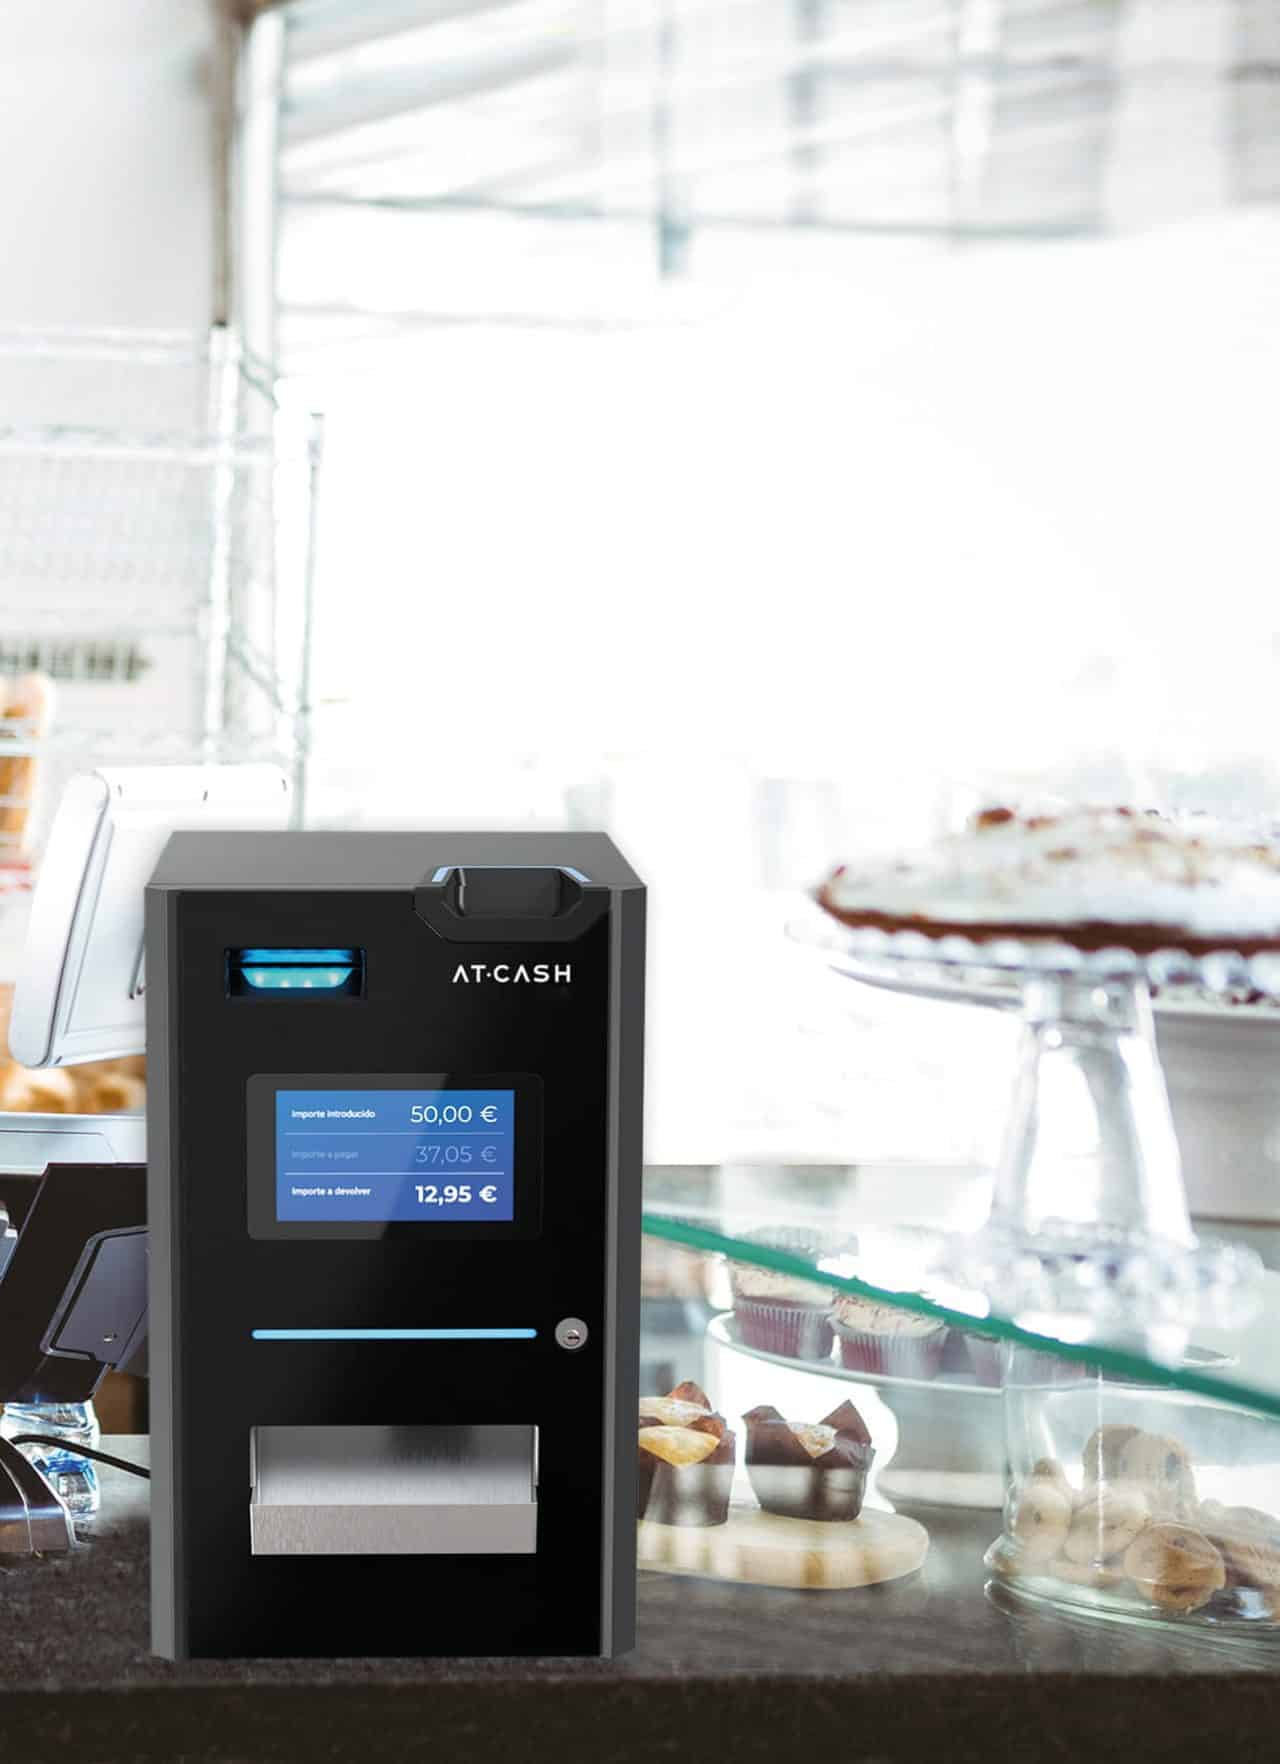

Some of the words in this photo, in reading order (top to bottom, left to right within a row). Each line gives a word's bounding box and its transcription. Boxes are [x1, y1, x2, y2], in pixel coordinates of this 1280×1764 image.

[291, 1108, 326, 1120] Importe
[326, 1108, 376, 1119] introducido
[410, 1105, 473, 1127] 50,00
[479, 1105, 498, 1124] €
[415, 1145, 473, 1166] 37,05
[479, 1145, 498, 1164] €
[291, 1185, 327, 1197] Importe
[326, 1188, 333, 1196] a
[334, 1185, 372, 1196] devolver
[415, 1184, 473, 1206] 12,95
[478, 1184, 498, 1204] €
